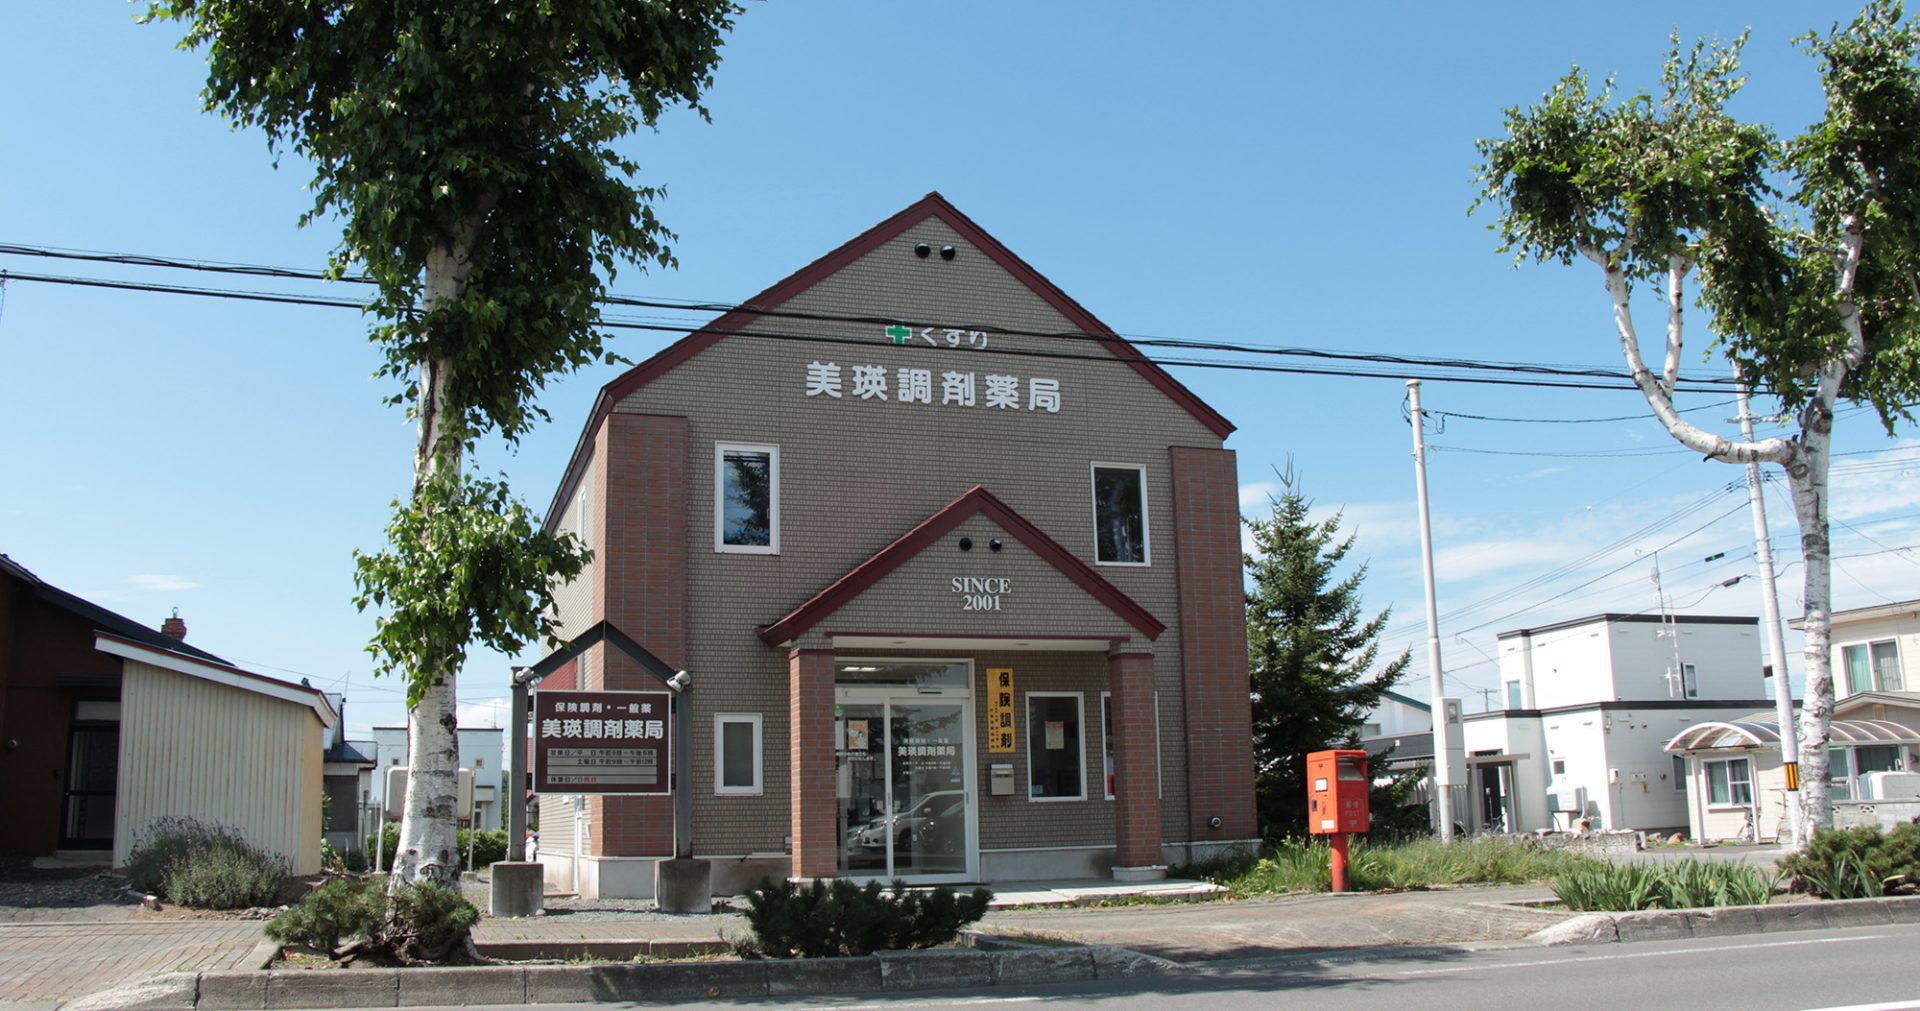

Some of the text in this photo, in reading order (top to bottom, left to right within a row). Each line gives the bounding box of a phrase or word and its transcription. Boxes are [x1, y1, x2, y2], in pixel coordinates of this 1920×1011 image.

[921, 327, 989, 350] くすり
[805, 360, 1062, 413] 美瑛調剤薬局
[951, 576, 1012, 594] SINCE
[962, 594, 1002, 611] 2001
[999, 671, 1013, 749] 保険調剤
[542, 718, 664, 739] 美瑛調剤薬局
